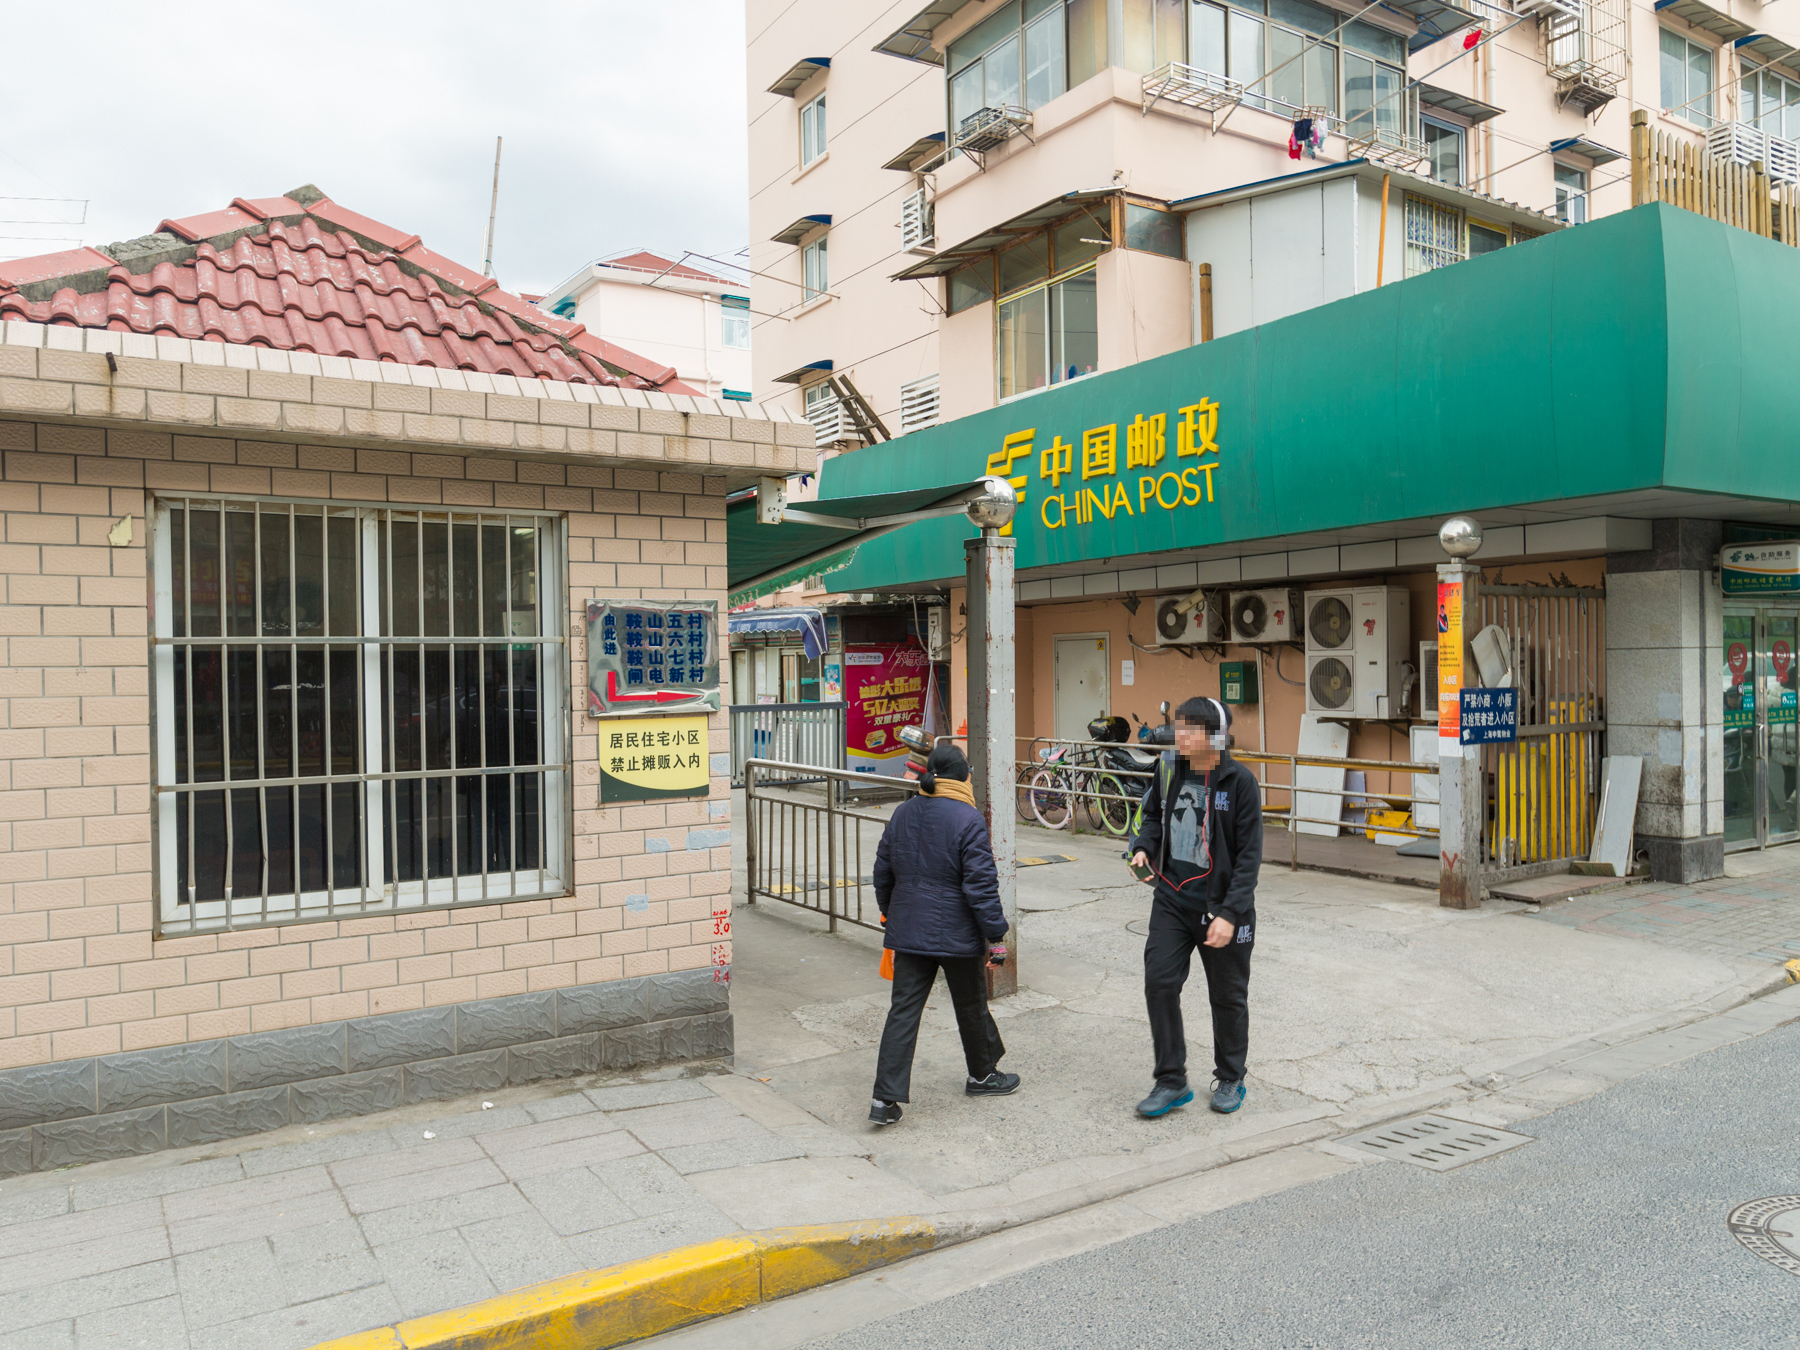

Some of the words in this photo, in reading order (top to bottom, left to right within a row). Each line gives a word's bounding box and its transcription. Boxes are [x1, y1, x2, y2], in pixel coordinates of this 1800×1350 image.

[1040, 397, 1220, 487] 中国邮政
[1041, 482, 1134, 529] CHINA
[1139, 462, 1219, 513] POST
[1761, 550, 1791, 558] 自助服务
[1730, 576, 1791, 585] 中国邮政储蓄银行
[626, 613, 703, 630] 鞍山五村
[604, 614, 617, 655] 由此进
[626, 631, 704, 648] 鞍山六村
[627, 649, 704, 666] 鞍山七村
[628, 667, 705, 684] 闸电新村
[859, 676, 922, 699] 体彩大乐透
[1462, 711, 1515, 727] 及拾荒者进入小区
[610, 730, 700, 749] 居民住宅小区
[610, 752, 701, 773] 禁止摊贩入内
